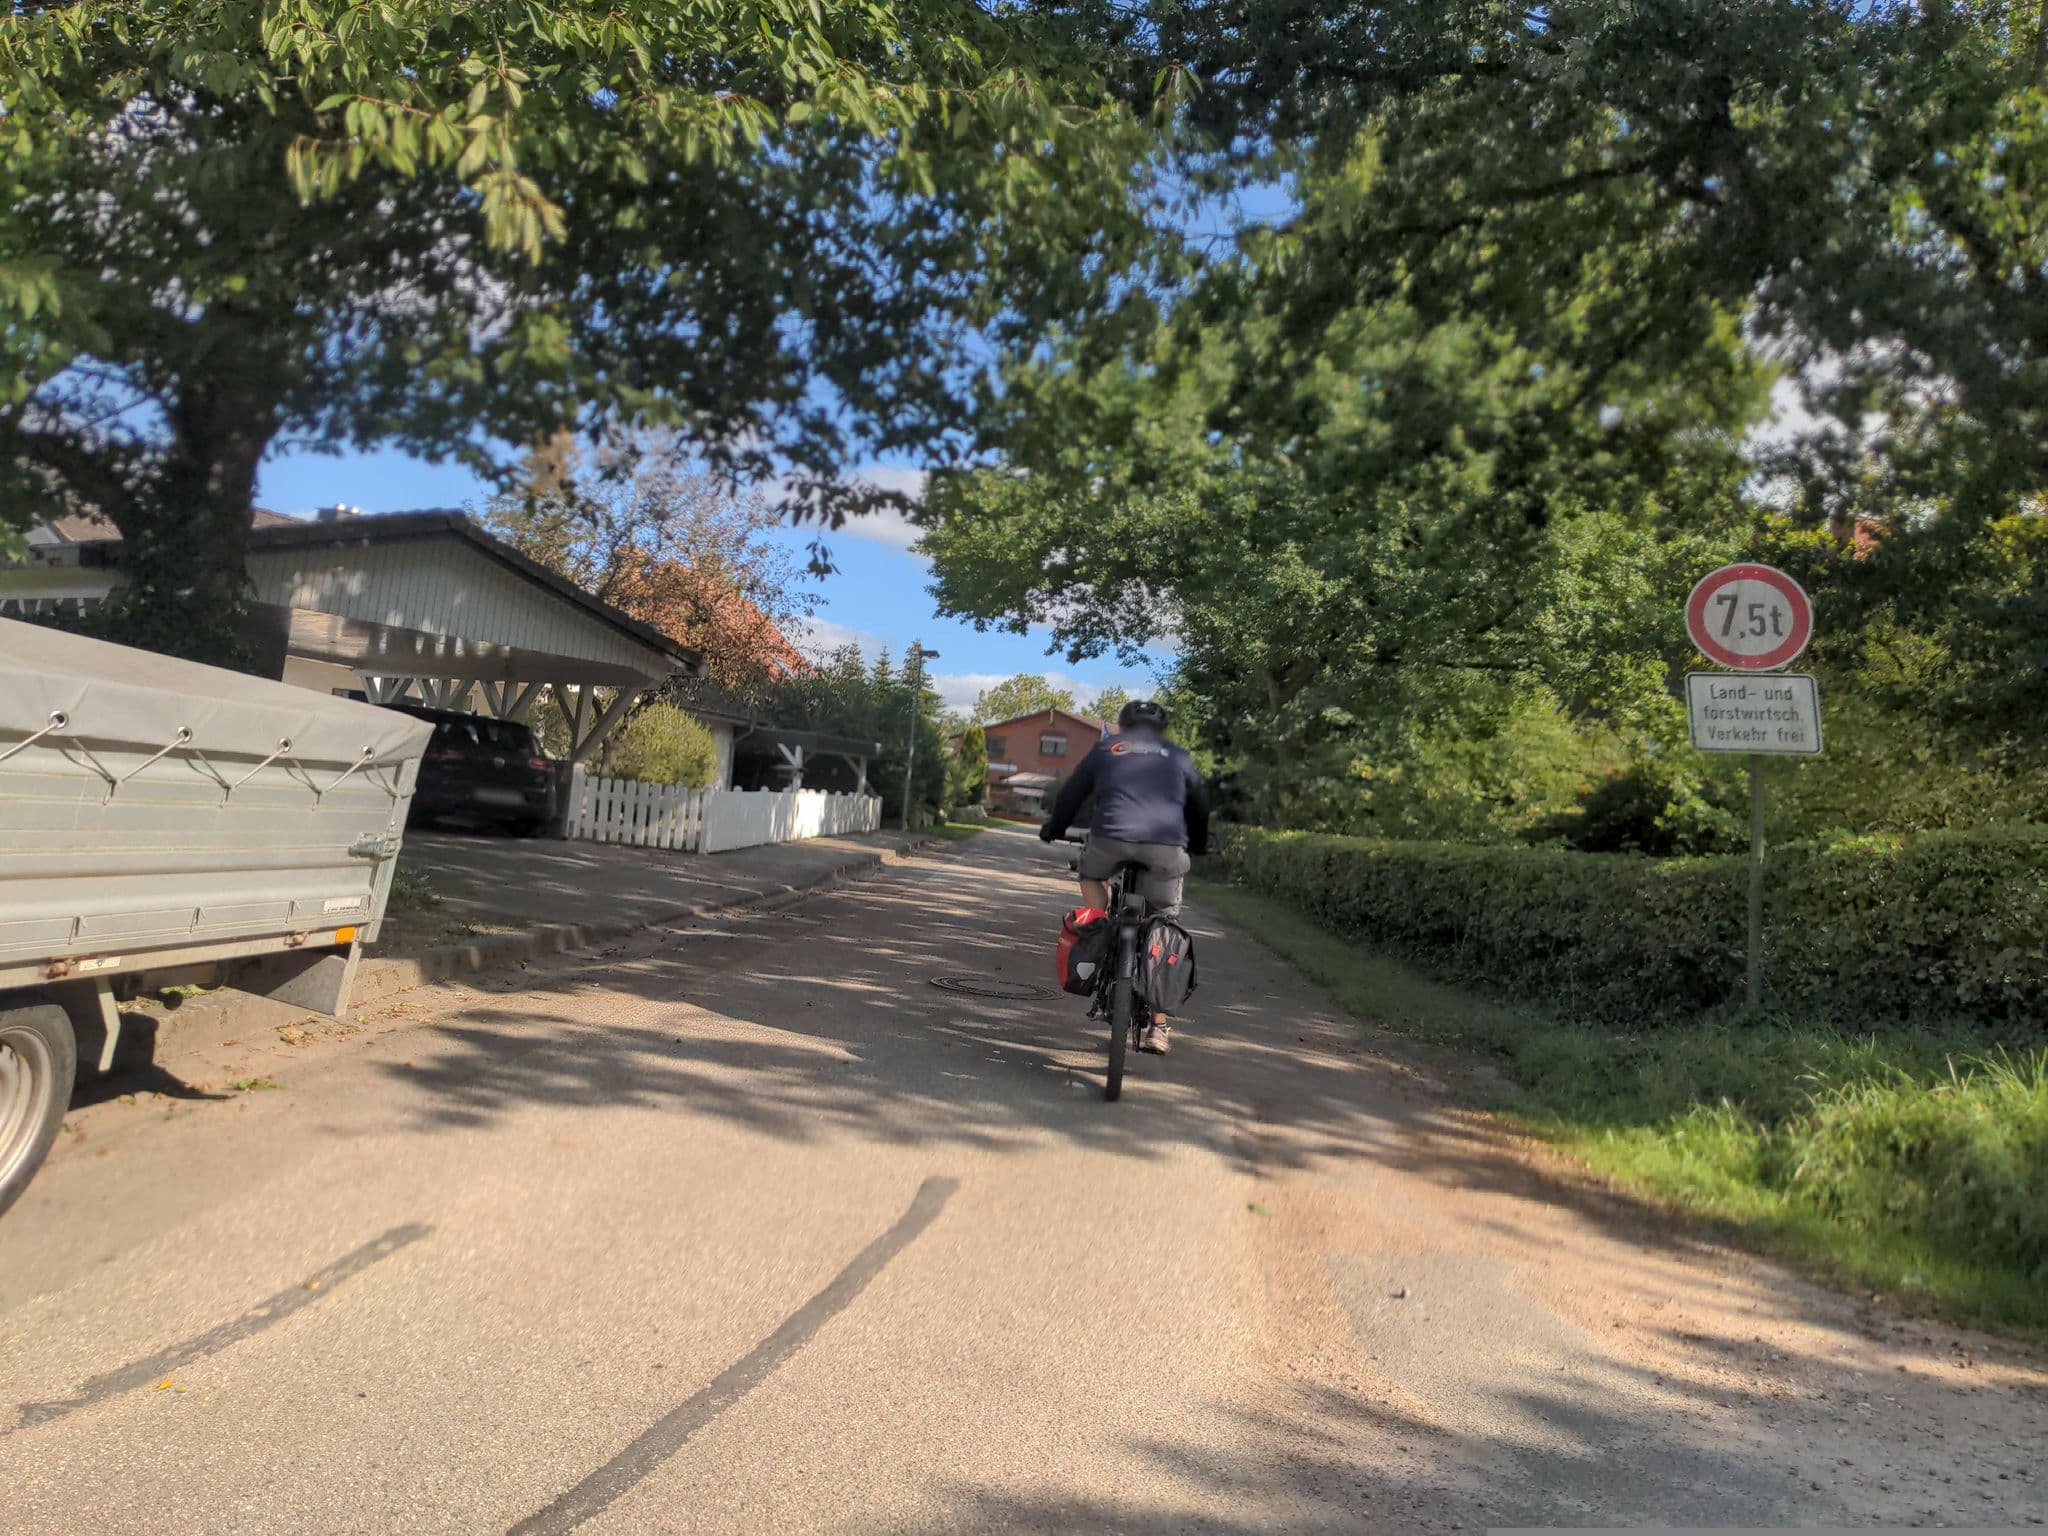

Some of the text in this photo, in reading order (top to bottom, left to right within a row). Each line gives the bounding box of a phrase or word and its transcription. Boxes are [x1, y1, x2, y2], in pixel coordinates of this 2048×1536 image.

[1710, 684, 1793, 701] Land- und
[1707, 727, 1805, 743] Verkehr frei
